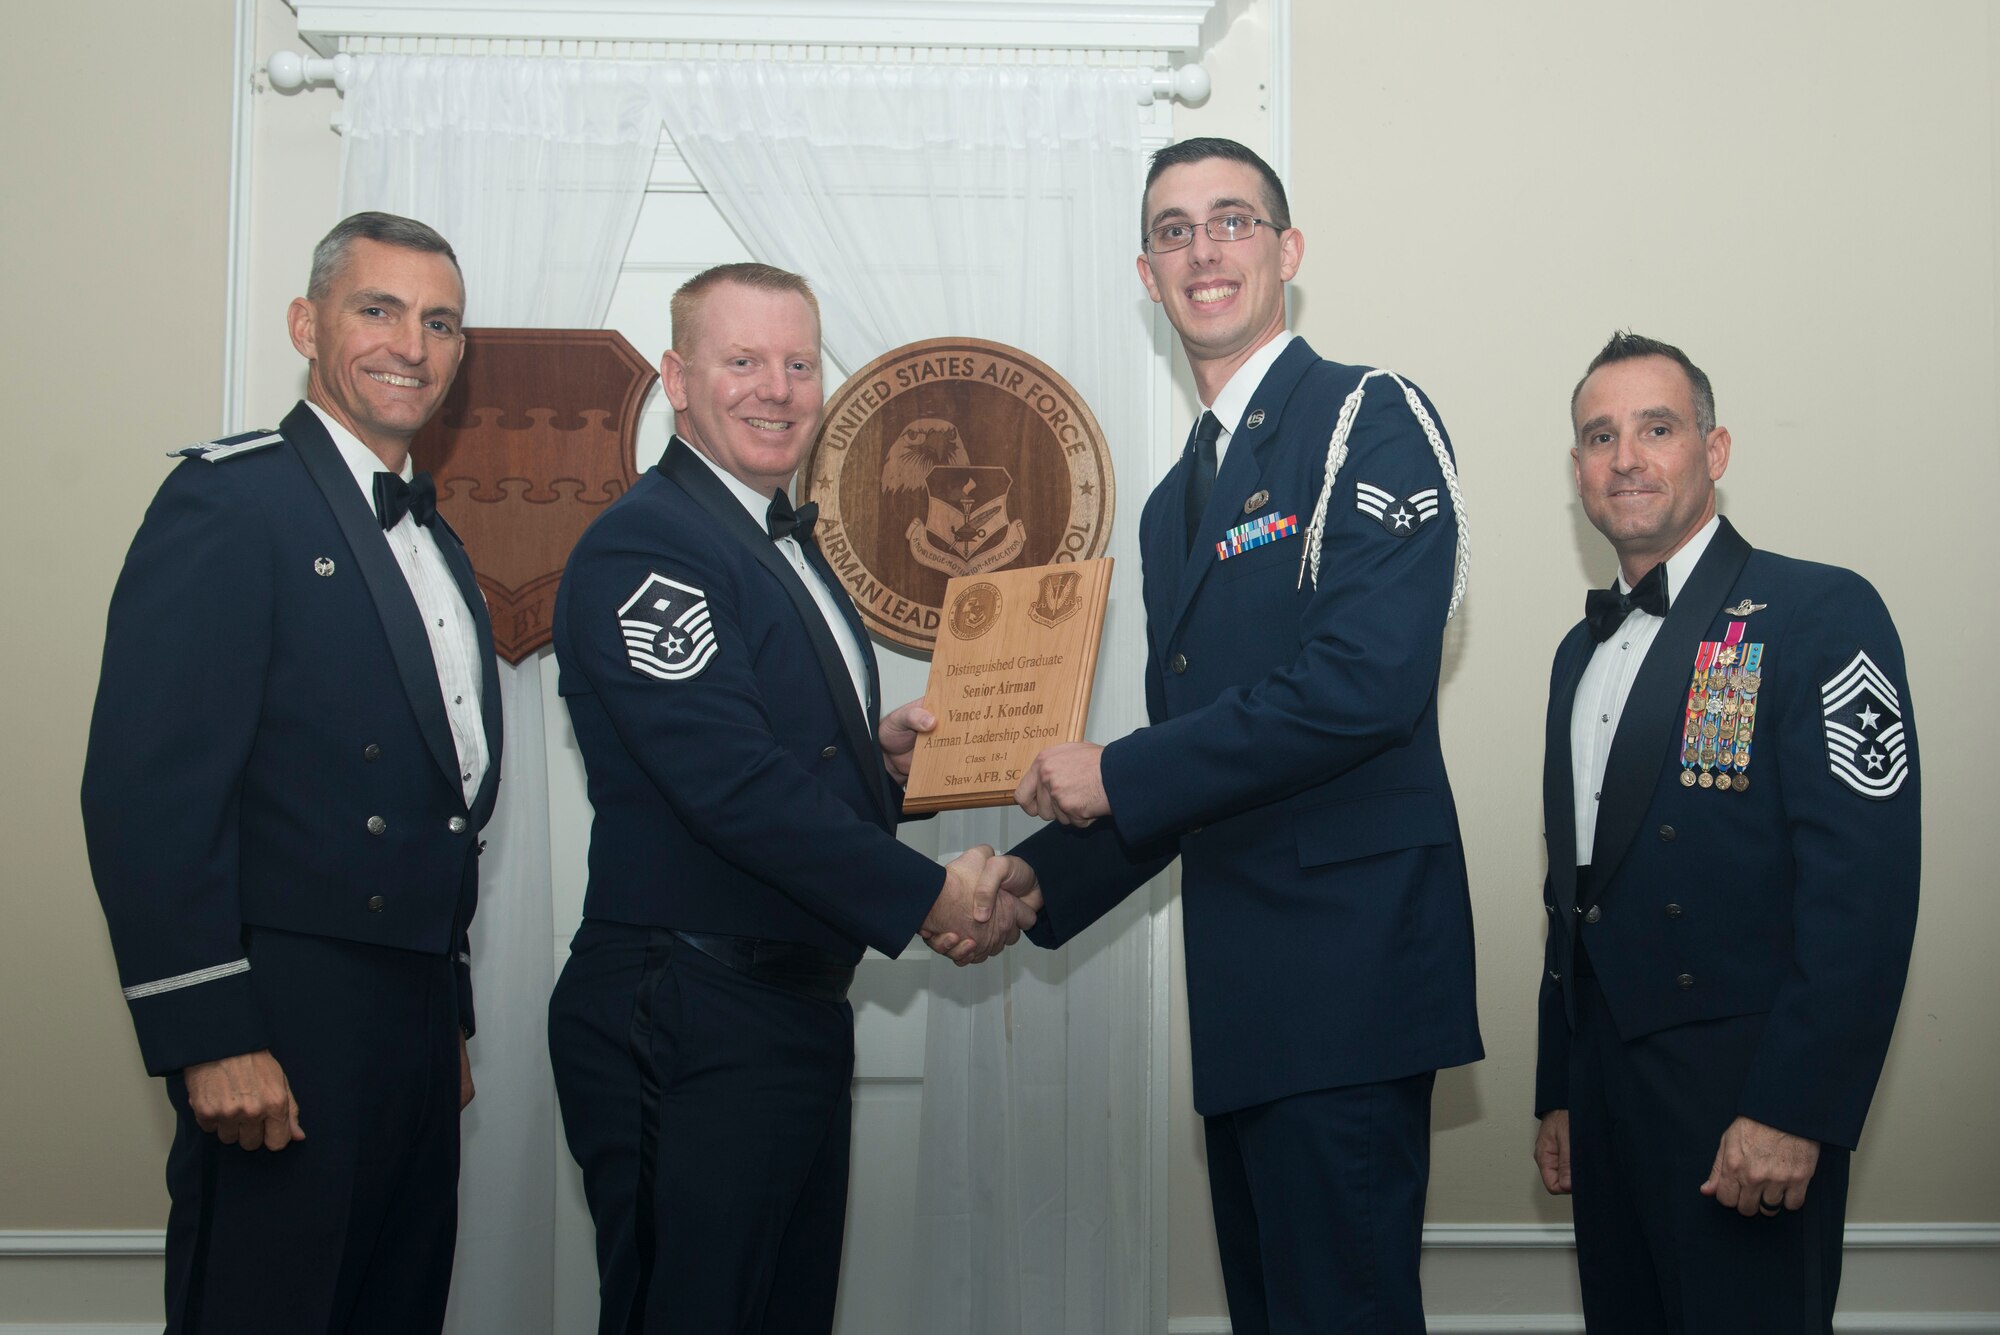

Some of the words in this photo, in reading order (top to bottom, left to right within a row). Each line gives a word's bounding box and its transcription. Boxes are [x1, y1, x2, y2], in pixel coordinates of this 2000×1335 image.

[828, 380, 891, 451] UNITED
[896, 357, 975, 388] STATES
[981, 362, 1024, 391] AIR
[1025, 383, 1087, 457] FORCE
[818, 516, 883, 606] AIRMAN
[881, 594, 941, 629] LEAD
[1055, 522, 1091, 564] OOL
[512, 599, 545, 642] BY
[946, 659, 1014, 678] Distinguished
[1018, 653, 1064, 669] Graduate
[962, 682, 996, 698] Senior
[998, 680, 1036, 696] Airman
[948, 706, 982, 723] Vance
[984, 704, 994, 720] J.
[997, 702, 1044, 719] Kondon
[924, 734, 961, 749] Airman
[964, 728, 1020, 746] Leadership
[1022, 723, 1060, 740] School
[965, 753, 986, 764] Class
[991, 752, 1008, 762] 18-1
[944, 773, 972, 787] Shaw
[975, 770, 1002, 785] AFB,
[1004, 768, 1021, 781] SC
